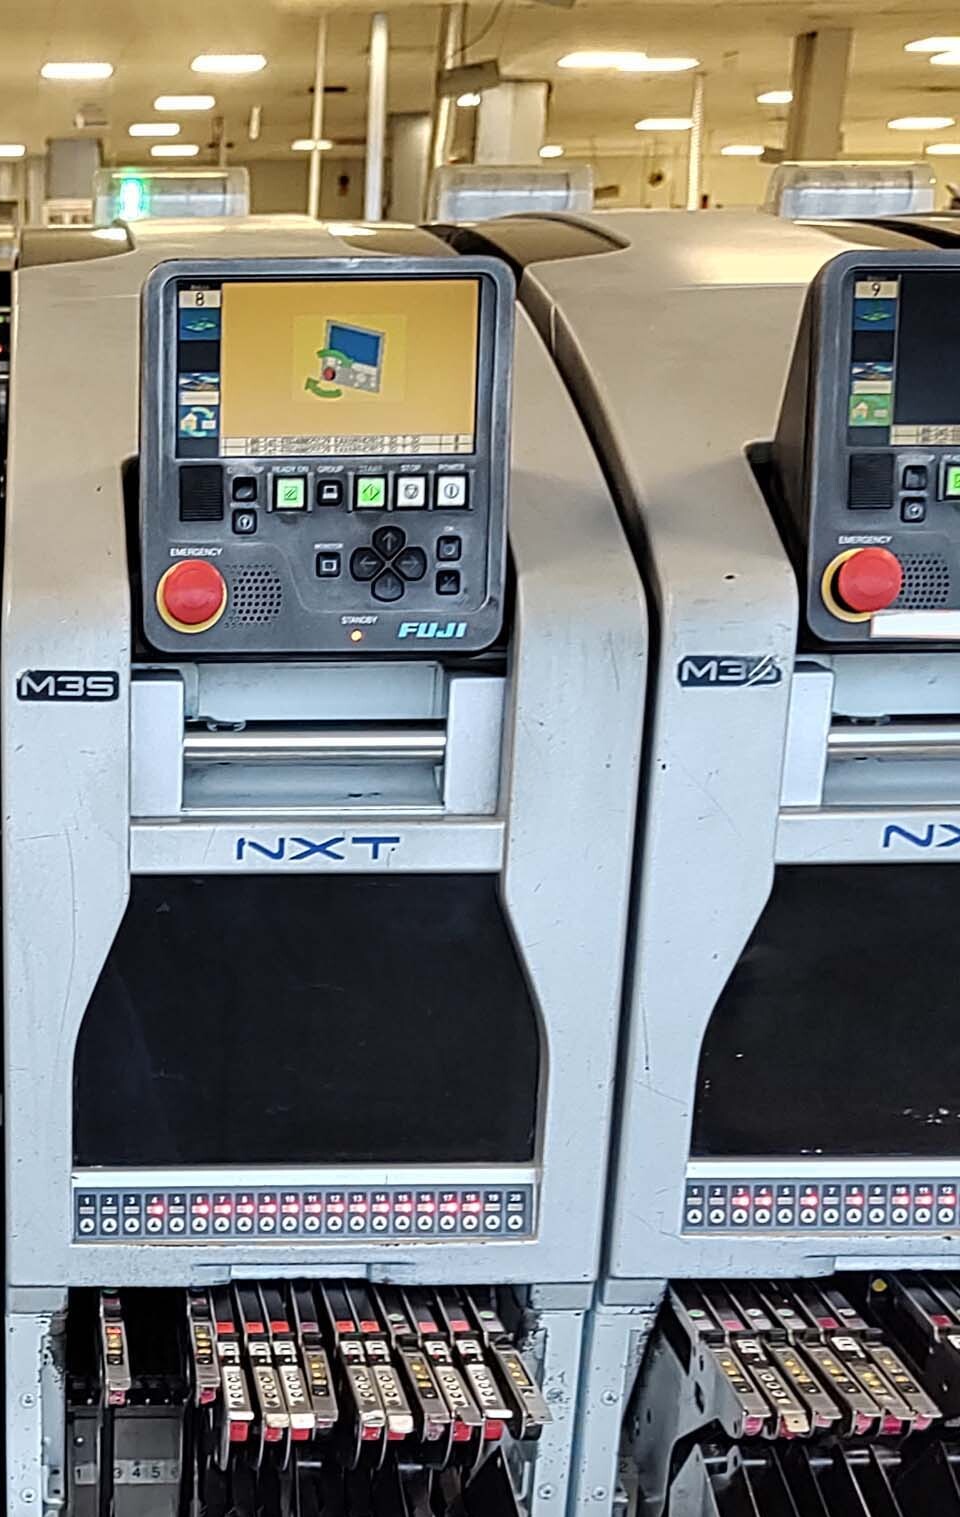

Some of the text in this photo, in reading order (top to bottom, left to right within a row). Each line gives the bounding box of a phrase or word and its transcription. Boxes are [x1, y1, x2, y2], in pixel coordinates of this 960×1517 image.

[871, 282, 881, 297] 9
[195, 291, 205, 307] 8
[272, 465, 296, 473] READY
[297, 465, 310, 473] ON
[316, 465, 344, 474] GROUP
[400, 463, 421, 473] STOP
[838, 535, 893, 545] EMERGENCY
[169, 547, 223, 557] EMERGENCY
[340, 615, 378, 625] STANDBY
[398, 622, 468, 638] FUJI
[20, 675, 115, 698] M3S
[236, 836, 400, 860] NXT
[895, 1186, 907, 1195] 10
[942, 1186, 953, 1195] 12
[307, 1195, 317, 1203] 11
[330, 1194, 341, 1203] 12
[353, 1194, 363, 1202] 13
[375, 1194, 386, 1202] 14
[398, 1194, 408, 1202] 15
[420, 1194, 431, 1202] 16
[443, 1194, 454, 1202] 17
[488, 1194, 499, 1202] 19
[132, 1467, 141, 1477] 4
[151, 1466, 161, 1479] 5
